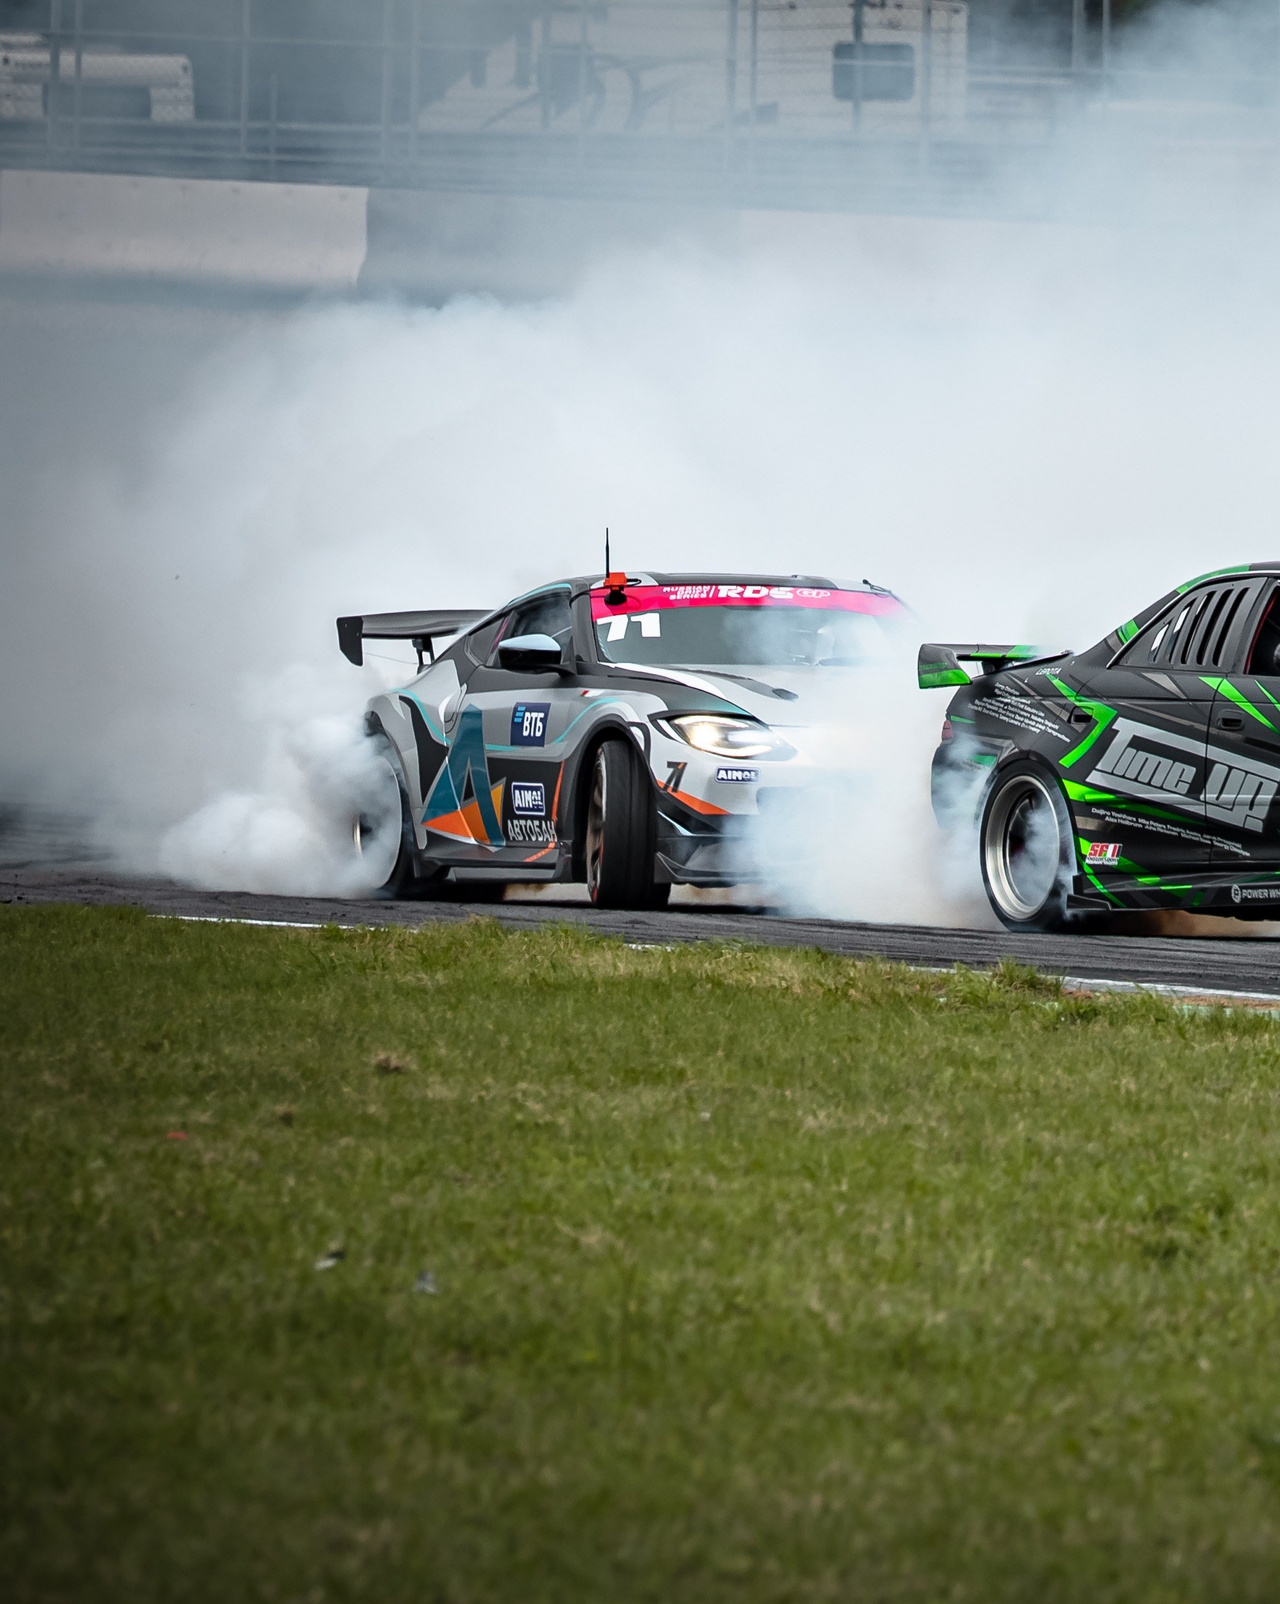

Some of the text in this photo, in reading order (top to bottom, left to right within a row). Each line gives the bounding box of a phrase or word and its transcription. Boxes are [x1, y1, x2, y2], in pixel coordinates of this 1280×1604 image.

[717, 585, 794, 599] RDS
[596, 612, 662, 642] 71
[522, 711, 545, 737] ВТБ
[1242, 888, 1269, 899] POWER
